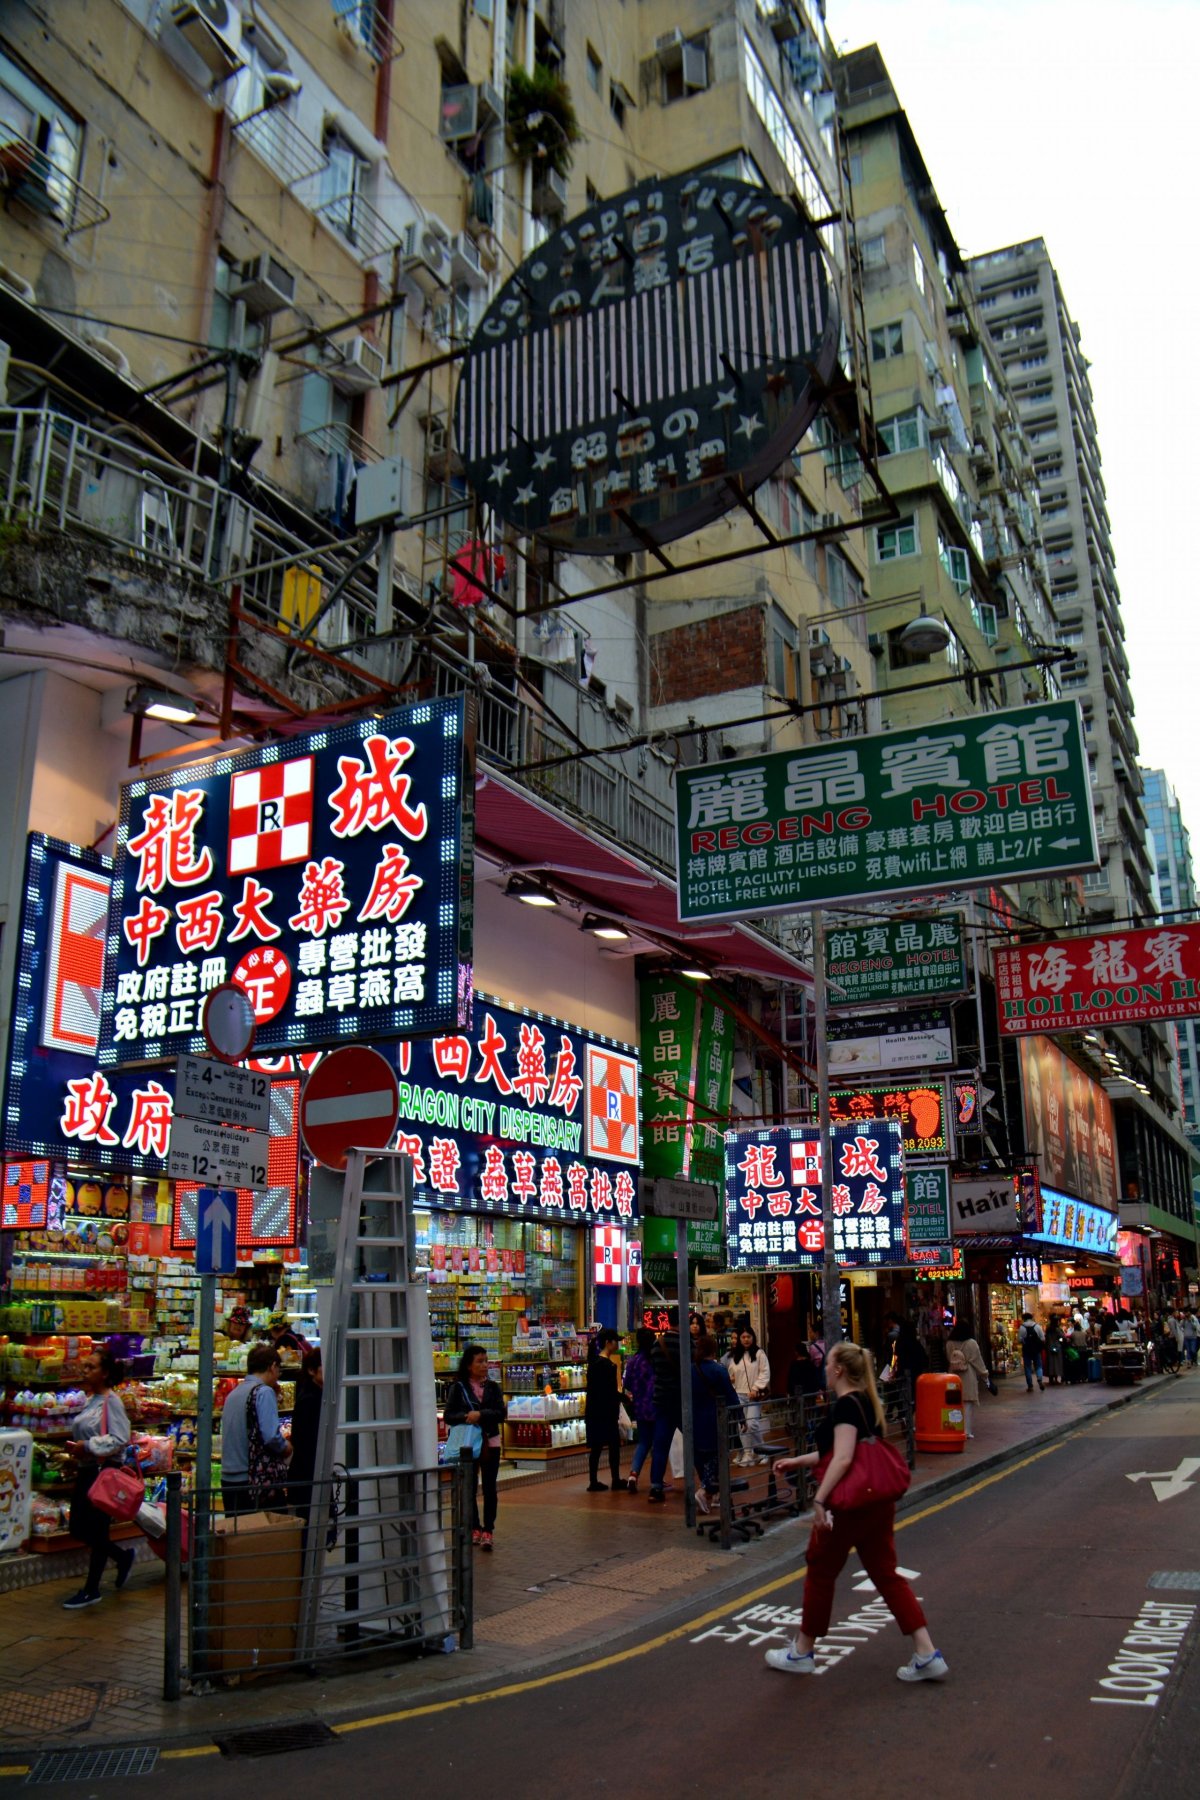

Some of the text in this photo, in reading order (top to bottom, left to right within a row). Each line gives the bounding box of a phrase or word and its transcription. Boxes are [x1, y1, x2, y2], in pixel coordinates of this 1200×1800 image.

[686, 715, 1071, 830] 麗晶賓館
[127, 788, 214, 894] 龍
[328, 733, 429, 841] 城
[690, 776, 1072, 856] REGENG HOTEL
[687, 802, 1078, 880] 持牌賓館 酒店設備 豪華套房 歡迎自由行
[687, 860, 857, 895] HOTEL FACILITY LIENSED
[687, 881, 801, 908] HOTEL FREE WIFI
[123, 842, 424, 967] 中西大藥房
[297, 920, 428, 977] 專營批發
[828, 948, 960, 976] REGENG HOTEL
[1026, 931, 1200, 993] 海龍賓
[294, 964, 427, 1018] 蟲草燕窩
[1001, 991, 1065, 1020] HOI
[1070, 982, 1163, 1012] LOON
[113, 996, 208, 1042] 免稅正
[1031, 1014, 1074, 1029] HOTEL
[1149, 1002, 1185, 1017] OVER
[251, 1078, 266, 1098] 12
[649, 990, 682, 1146] 麗晶賓館
[193, 1124, 219, 1137] General
[399, 1080, 583, 1153] RAGON CITY DISPENSARY
[737, 1143, 786, 1189] 龍
[839, 1135, 888, 1183] 城
[917, 1136, 943, 1149] 2093
[171, 1150, 189, 1160] noon
[250, 1164, 266, 1185] 12
[911, 1171, 942, 1201] 館
[907, 1203, 945, 1216] OTEL
[956, 1188, 1010, 1219] Hair
[1090, 1600, 1198, 1706] LOOK RIGHT
